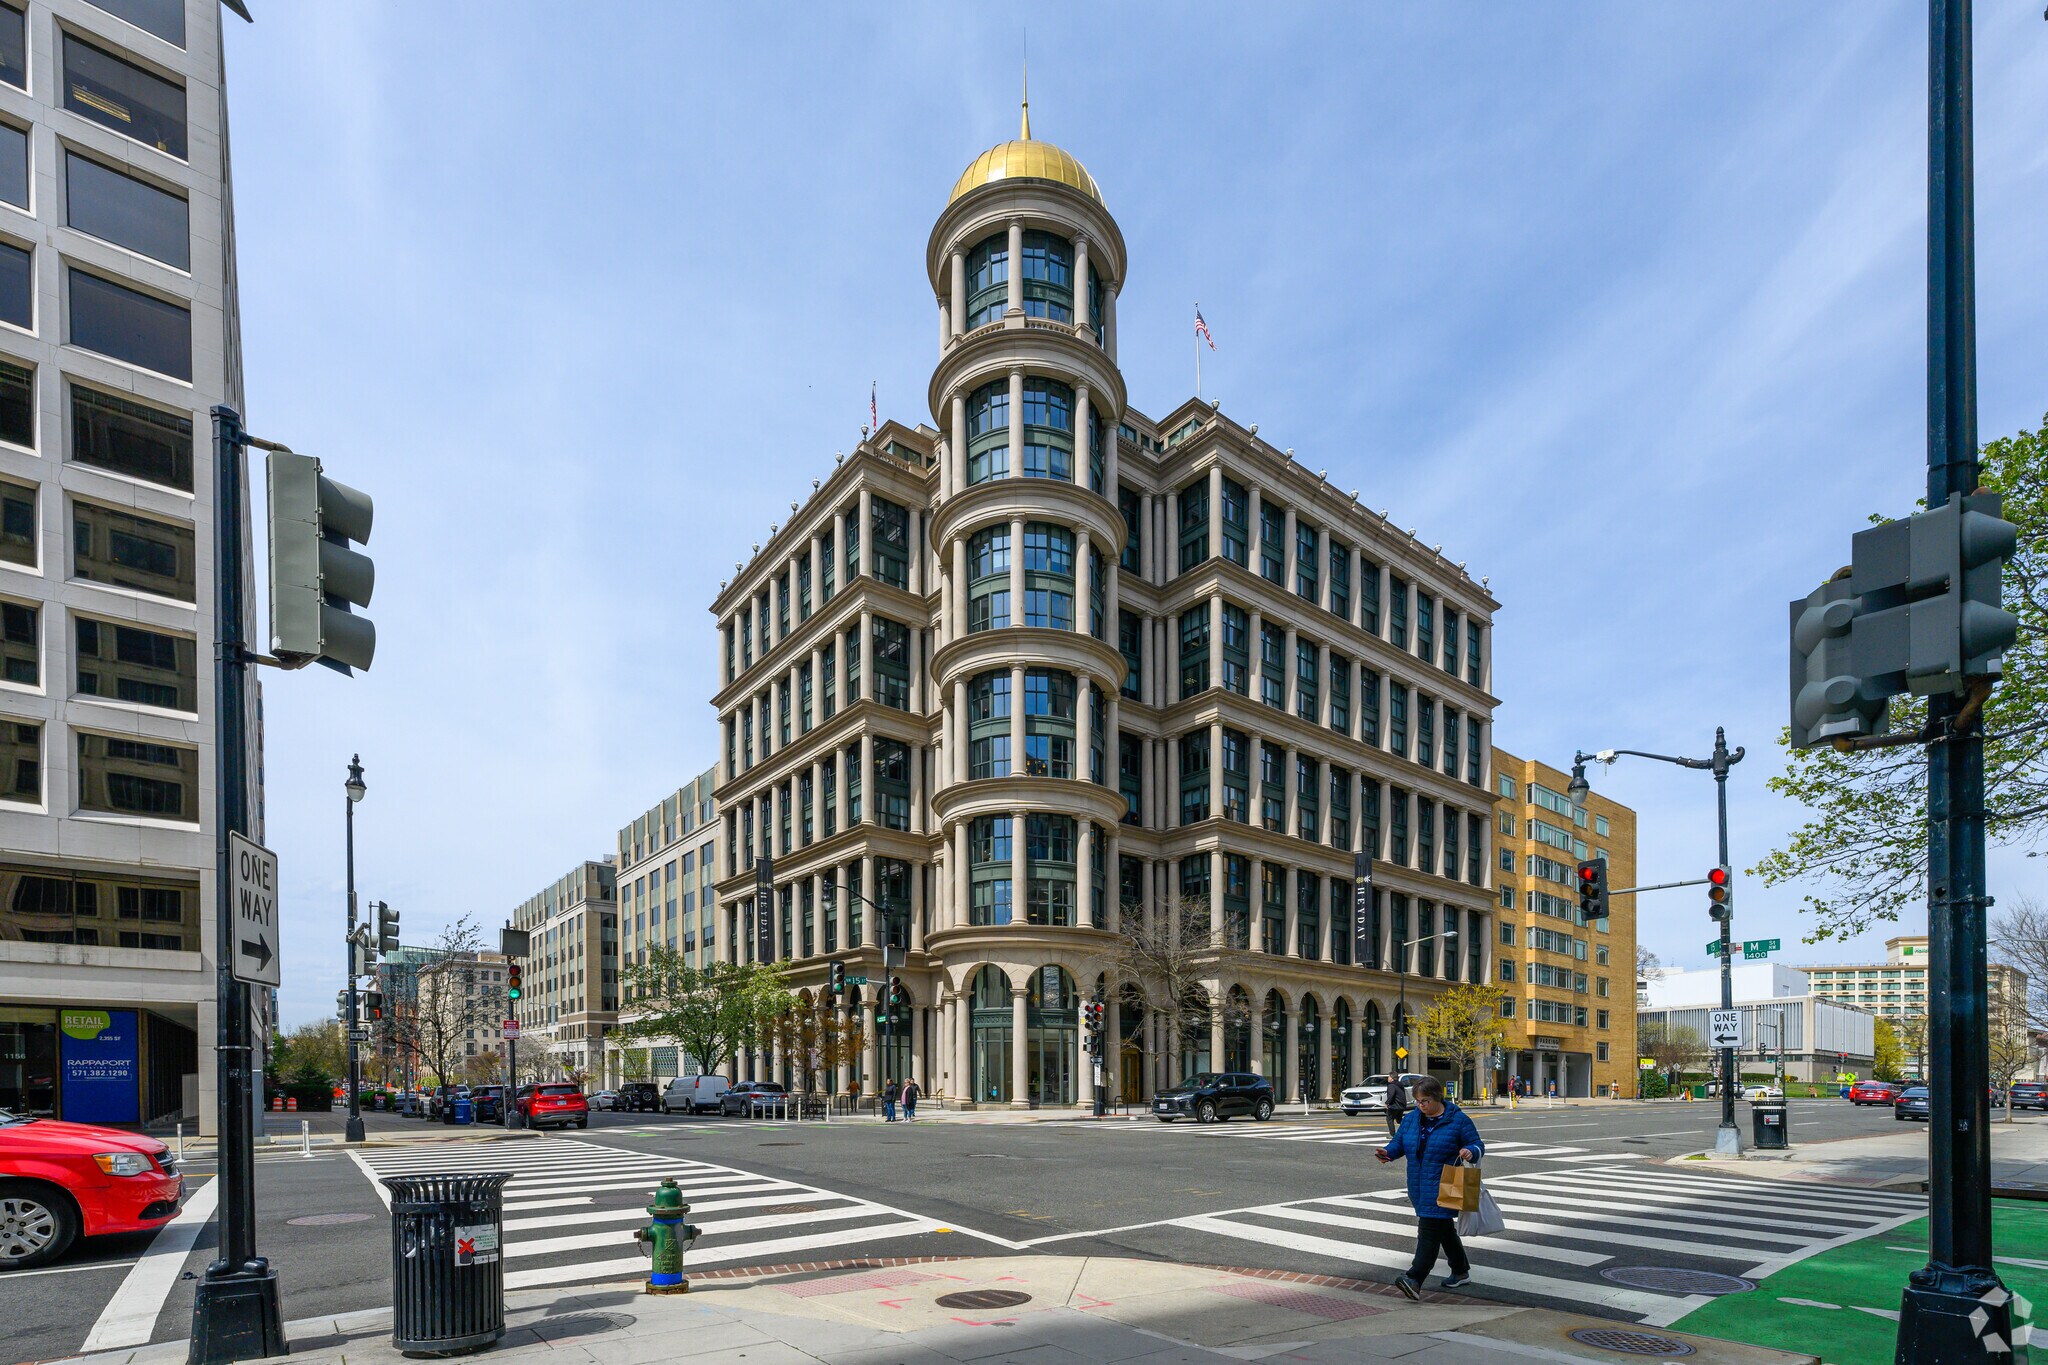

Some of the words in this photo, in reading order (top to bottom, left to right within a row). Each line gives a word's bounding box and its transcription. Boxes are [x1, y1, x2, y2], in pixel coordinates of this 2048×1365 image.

[241, 850, 271, 891] ONE
[239, 887, 272, 927] WAY
[760, 892, 768, 941] HEYDAY
[1357, 888, 1365, 940] HEYDAY
[1750, 942, 1759, 951] M
[64, 1016, 104, 1025] RETAIL
[1713, 1023, 1738, 1032] WAY
[1714, 1013, 1737, 1022] ONE
